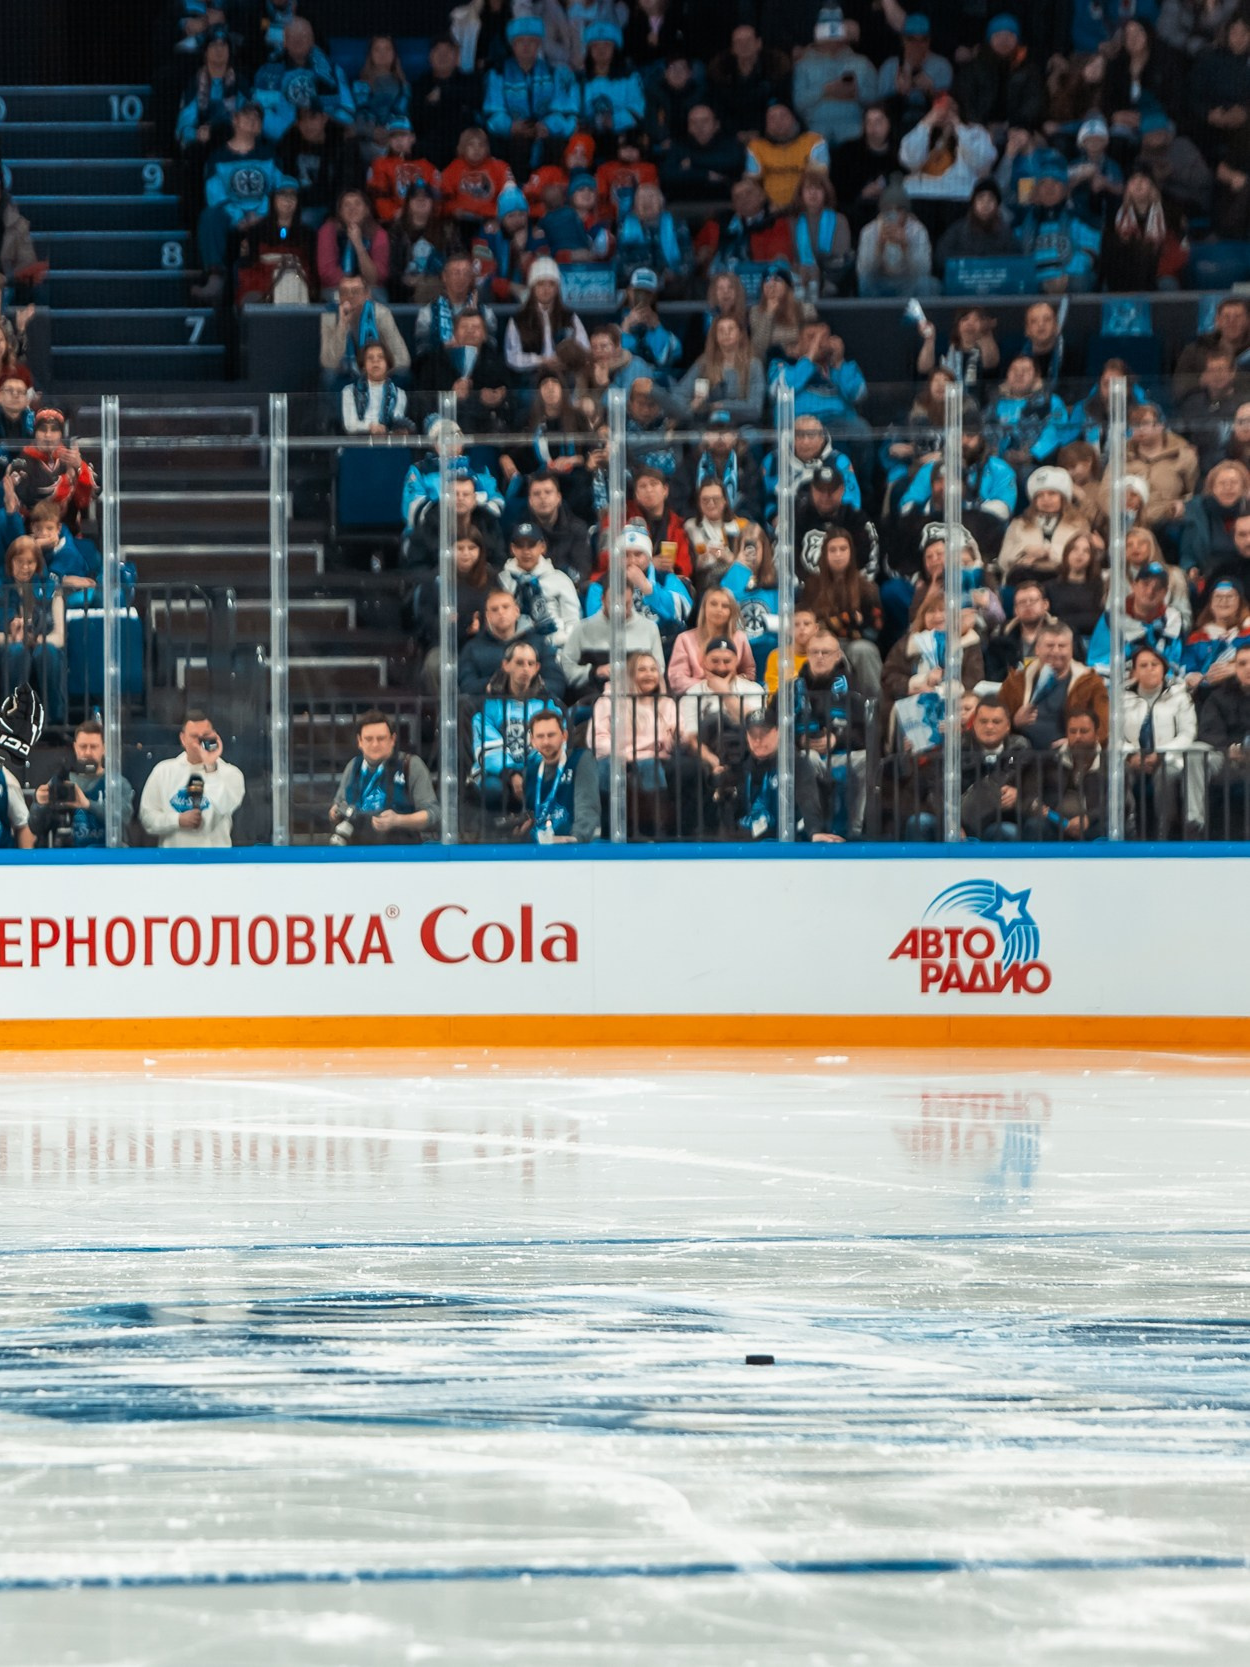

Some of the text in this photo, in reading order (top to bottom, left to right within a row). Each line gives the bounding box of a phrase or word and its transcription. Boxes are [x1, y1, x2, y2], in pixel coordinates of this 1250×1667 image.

[108, 95, 144, 122] 10
[142, 163, 164, 191] 9
[161, 241, 183, 268] 8
[185, 316, 205, 345] 7
[420, 903, 578, 964] Cola
[888, 926, 996, 960] АВТО
[920, 959, 1053, 995] РАДИО
